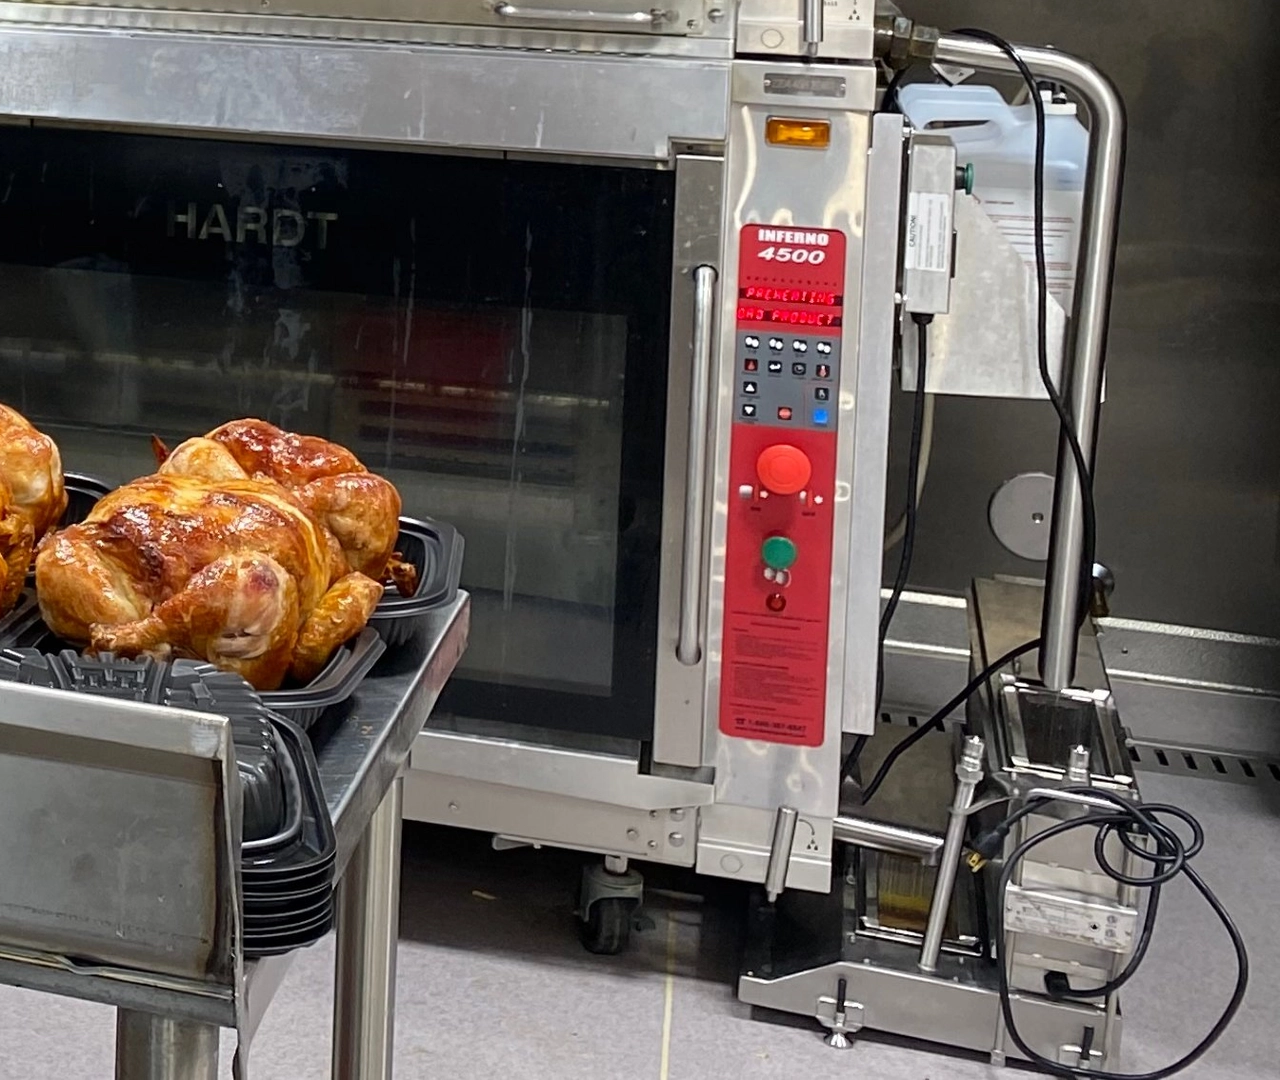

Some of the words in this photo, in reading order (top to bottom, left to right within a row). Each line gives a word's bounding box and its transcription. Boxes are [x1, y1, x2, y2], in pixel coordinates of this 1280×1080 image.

[167, 202, 338, 250] HARDT
[758, 229, 829, 246] INFERNO
[757, 247, 826, 265] 4500
